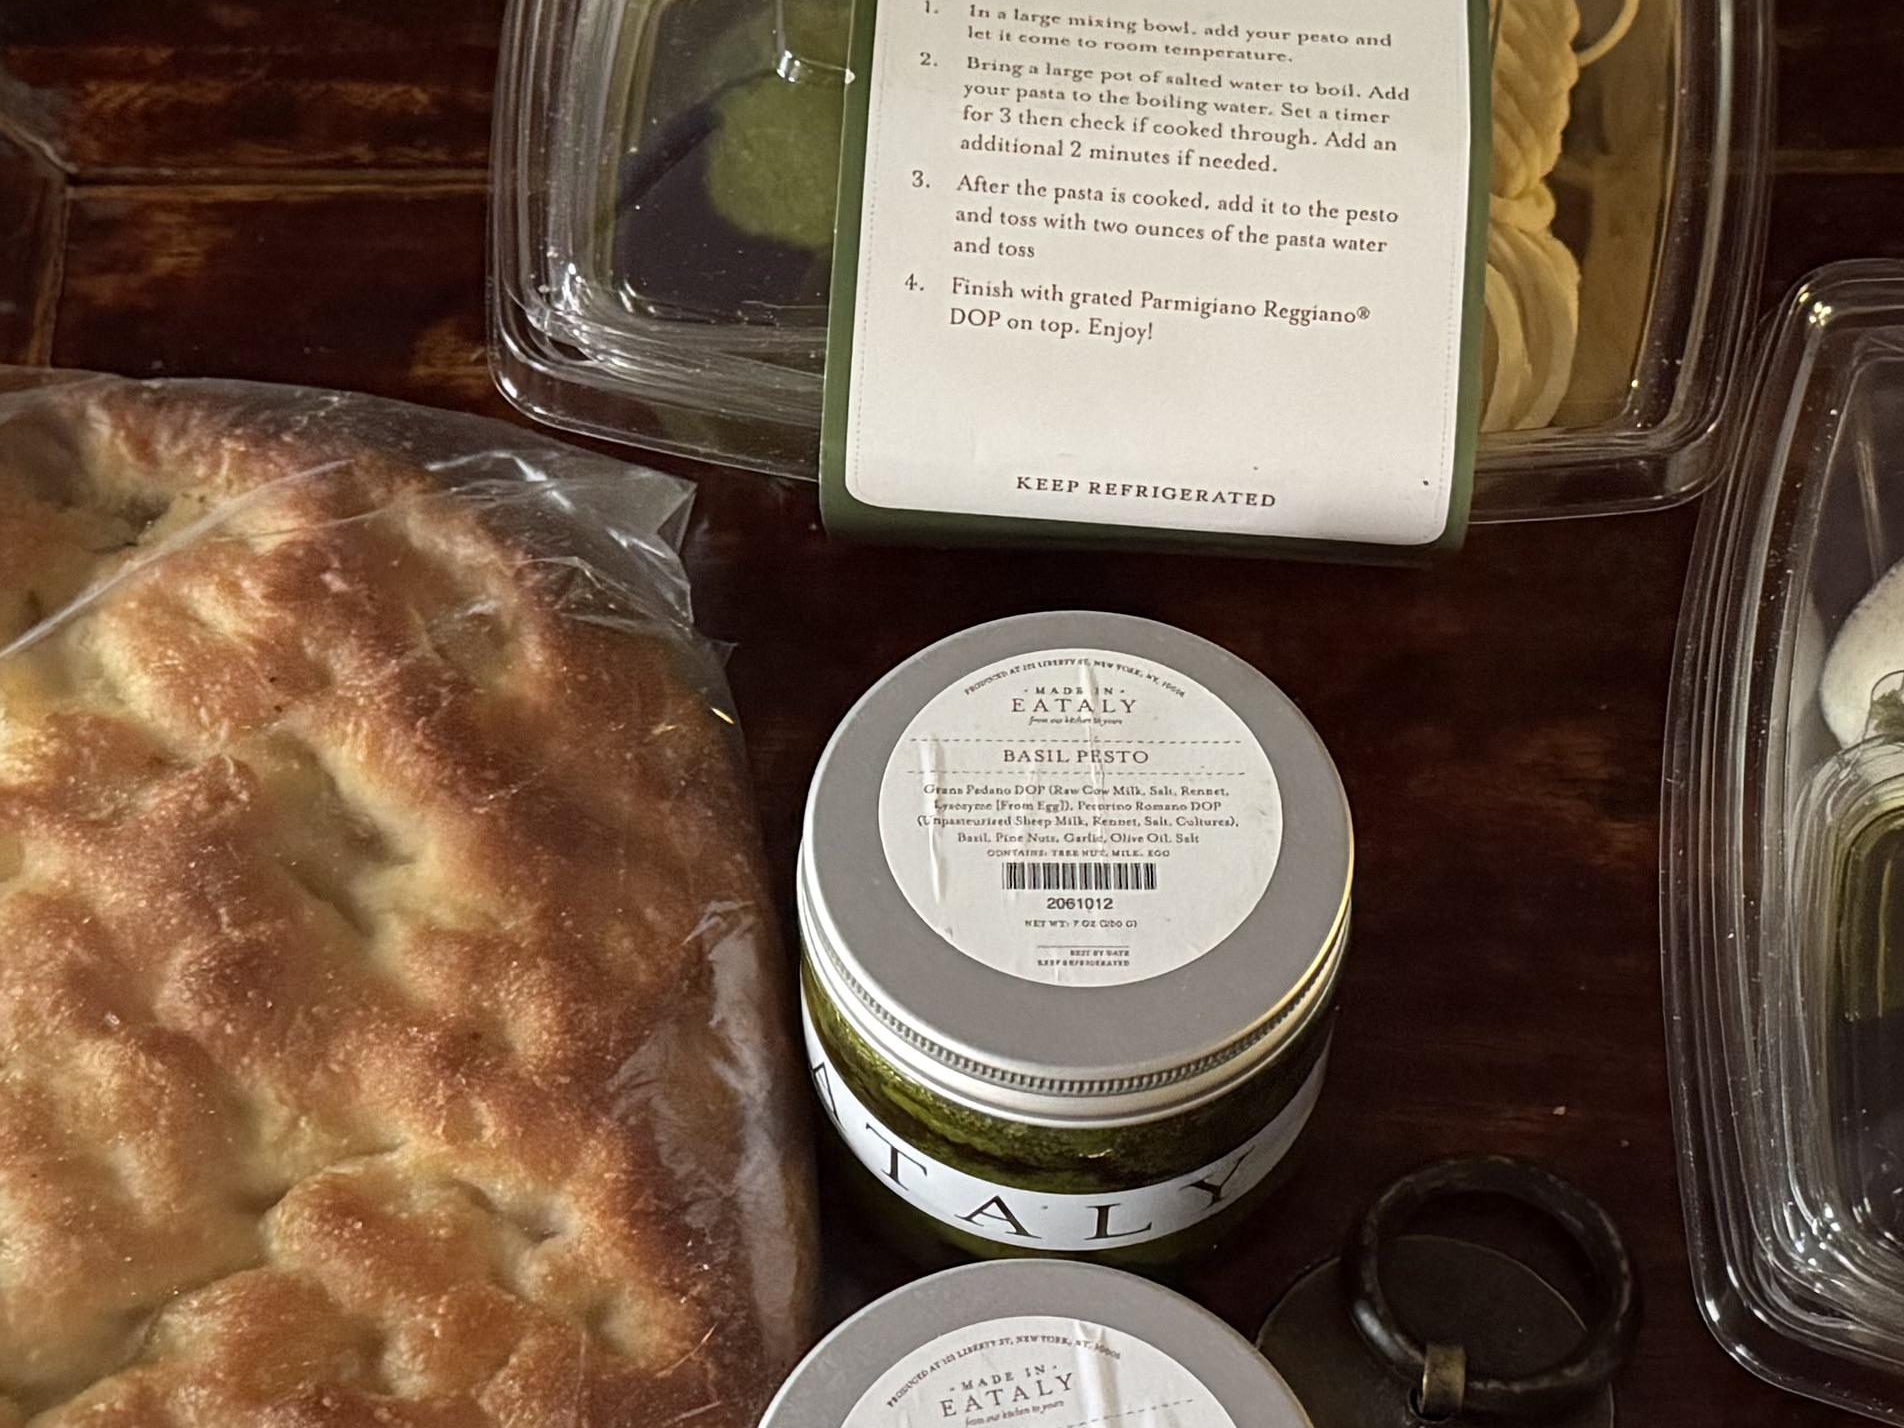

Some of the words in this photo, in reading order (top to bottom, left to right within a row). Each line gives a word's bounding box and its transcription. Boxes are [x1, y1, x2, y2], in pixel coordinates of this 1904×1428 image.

[962, 104, 994, 122] for
[999, 106, 1011, 124] 3
[1018, 108, 1063, 127] then
[1069, 112, 1125, 132] check
[1132, 116, 1150, 133] if
[1152, 120, 1223, 138] cooked
[1230, 123, 1317, 150] through.
[1324, 130, 1366, 149] Add
[1373, 139, 1397, 151] an
[904, 273, 924, 291] 4.
[952, 276, 1013, 298] Finish
[1020, 283, 1063, 302] with
[1069, 289, 1132, 310] grated
[1140, 290, 1257, 319] Parmigiano
[949, 307, 1001, 327] DOP
[1007, 317, 1033, 330] on
[1040, 318, 1080, 339] top.
[1088, 317, 1153, 345] Enjoy!
[1016, 476, 1079, 493] KEEP
[1088, 481, 1276, 507] REFRIGERATED
[1011, 698, 1136, 713] EATALY
[1003, 749, 1070, 763] BASIL
[1077, 750, 1149, 764] PESTO
[1046, 897, 1114, 910] 2061012
[961, 1372, 1014, 1390] MADE
[1025, 1364, 1045, 1377] IN
[940, 1372, 1072, 1417] EATALY
